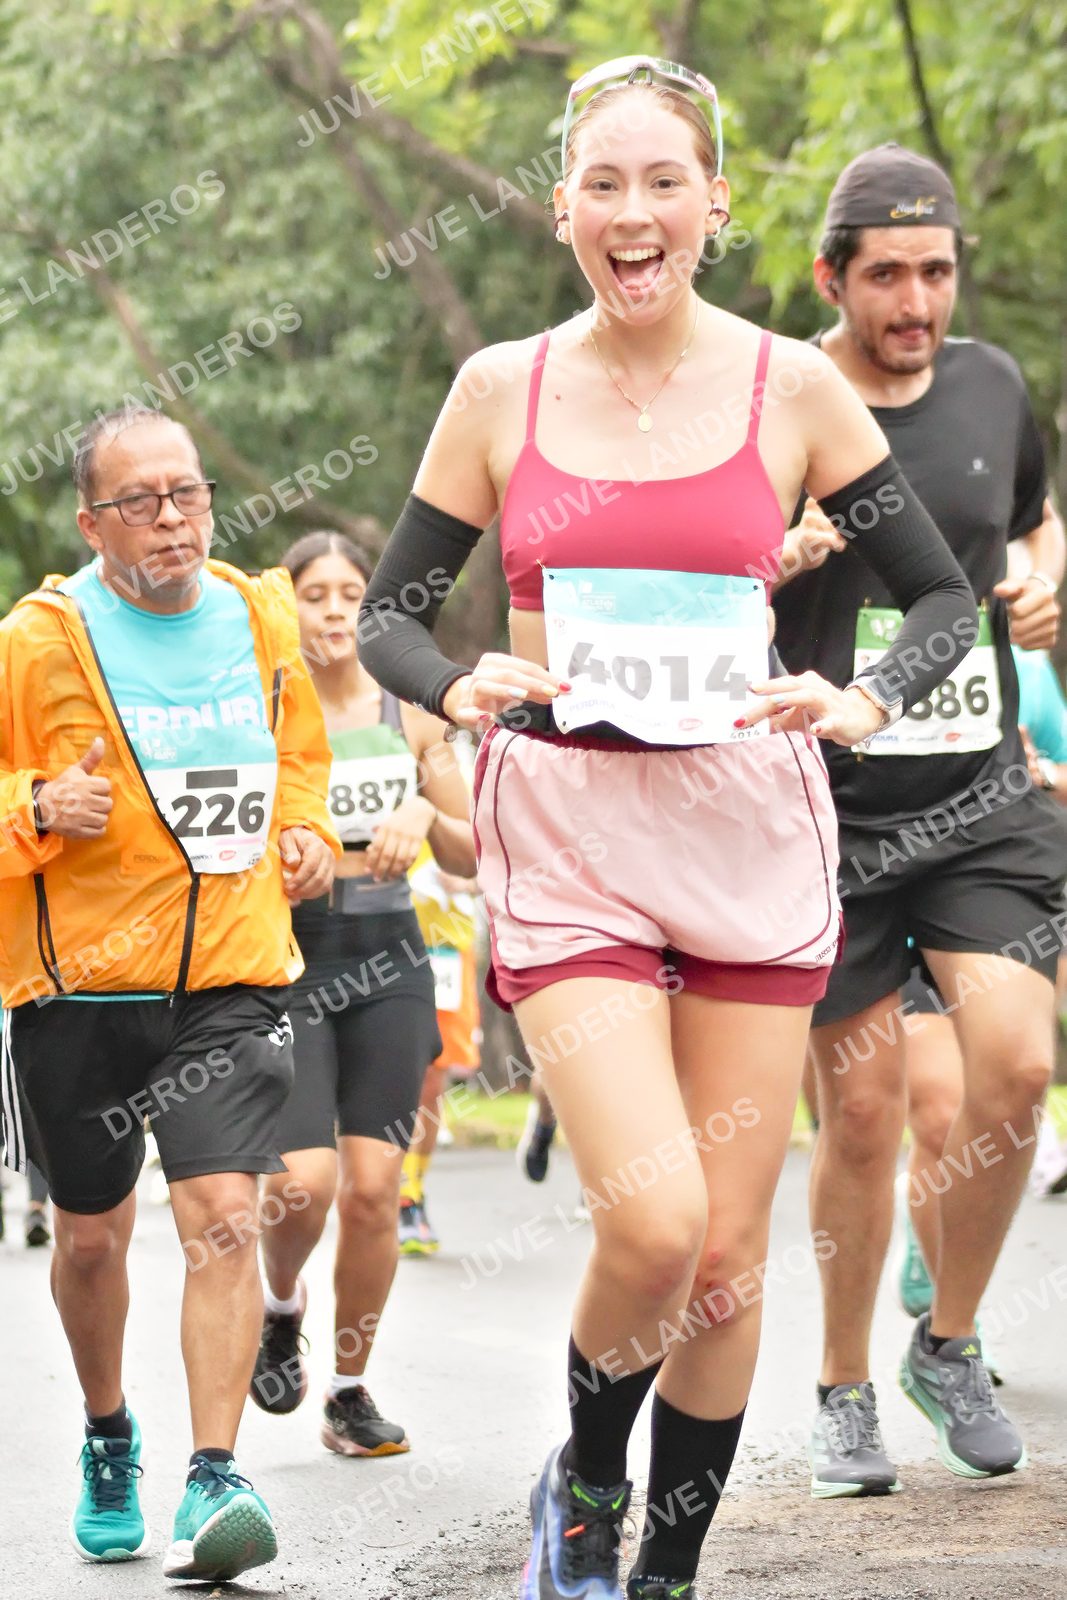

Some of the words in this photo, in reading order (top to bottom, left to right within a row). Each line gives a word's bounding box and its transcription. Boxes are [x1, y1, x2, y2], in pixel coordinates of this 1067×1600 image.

[568, 641, 752, 702] 4014
[156, 791, 266, 838] 226
[331, 778, 407, 816] 887
